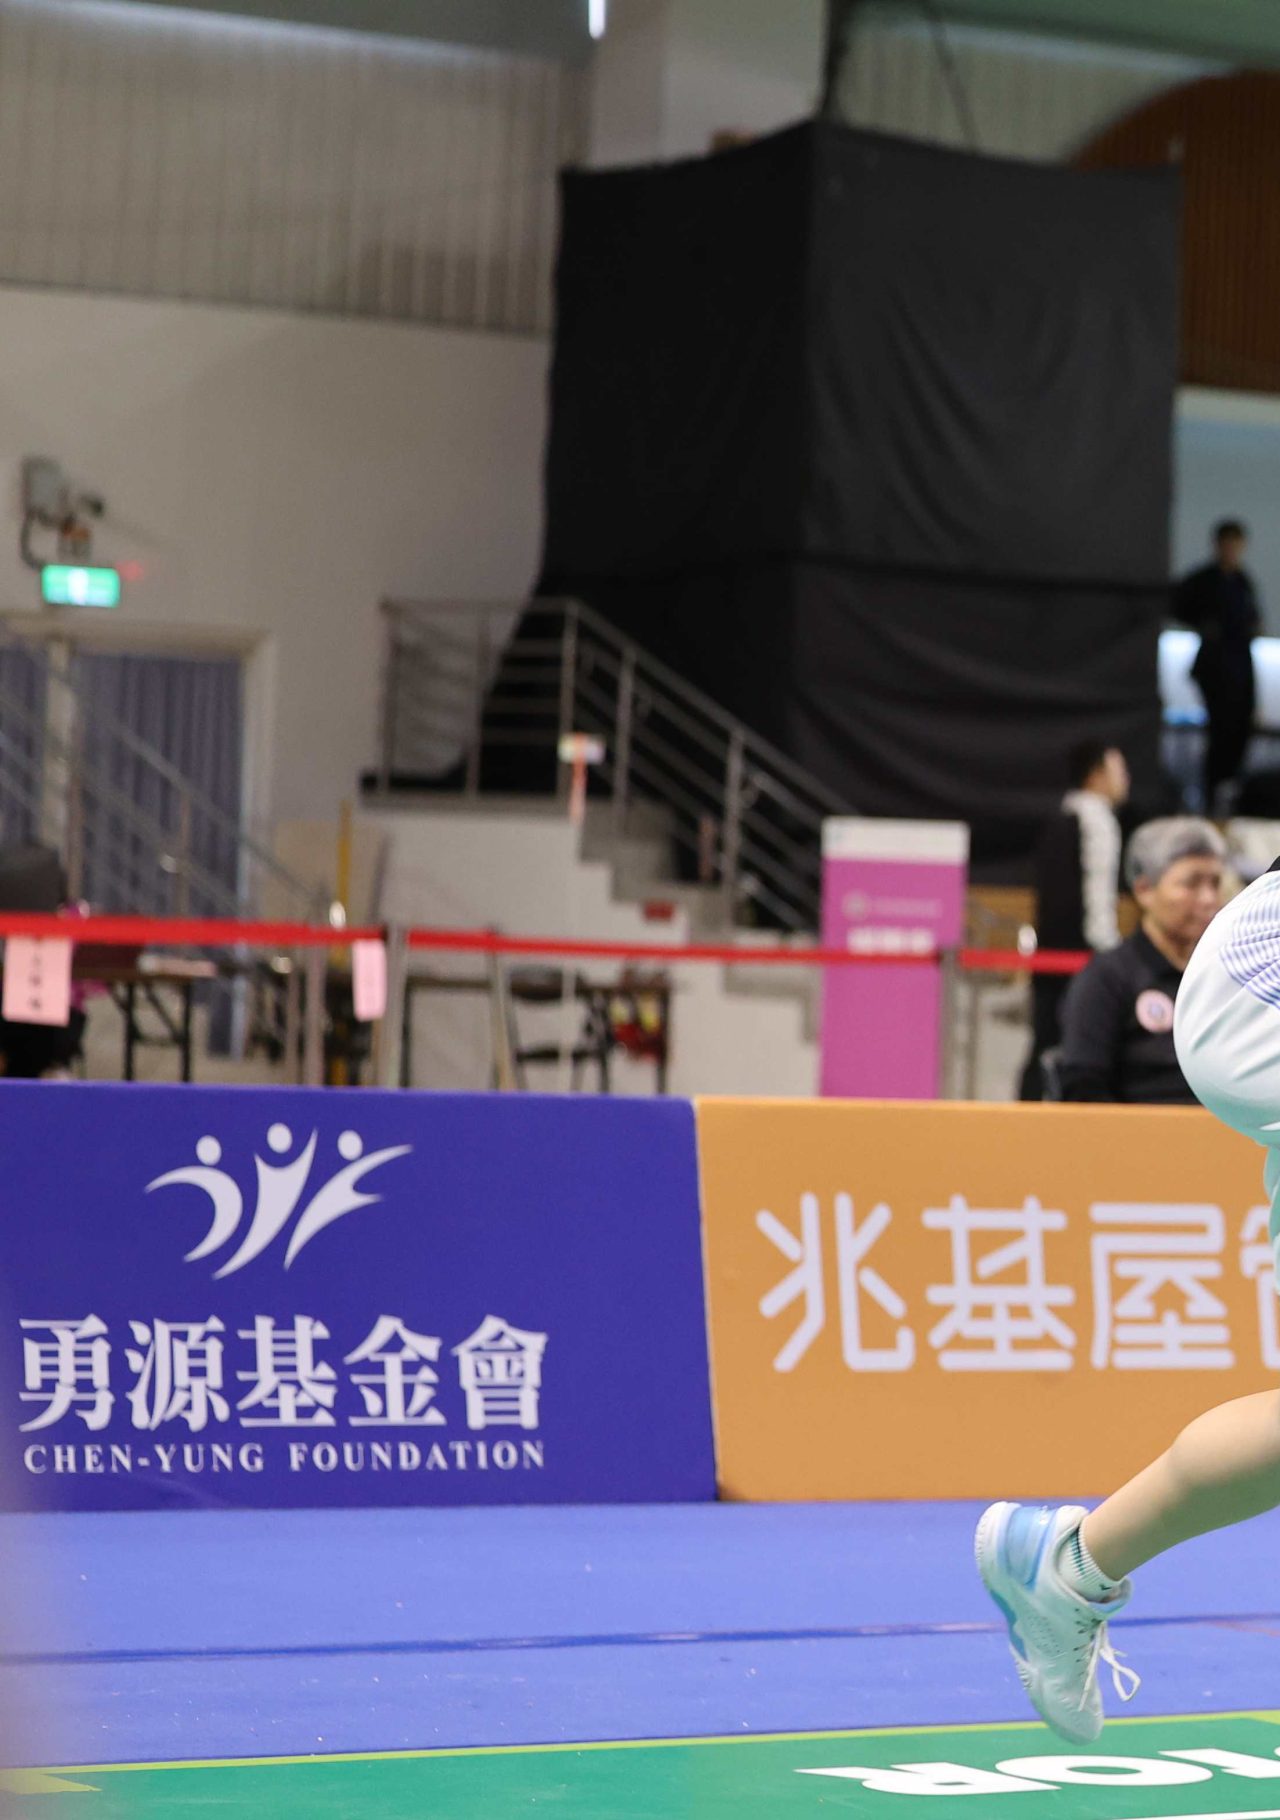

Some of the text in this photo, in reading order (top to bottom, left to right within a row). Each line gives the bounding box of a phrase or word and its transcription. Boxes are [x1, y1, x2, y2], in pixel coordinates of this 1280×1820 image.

[18, 1312, 549, 1433] 勇源基金會
[23, 1440, 545, 1474] CHEN-YUNG FOUNDATION
